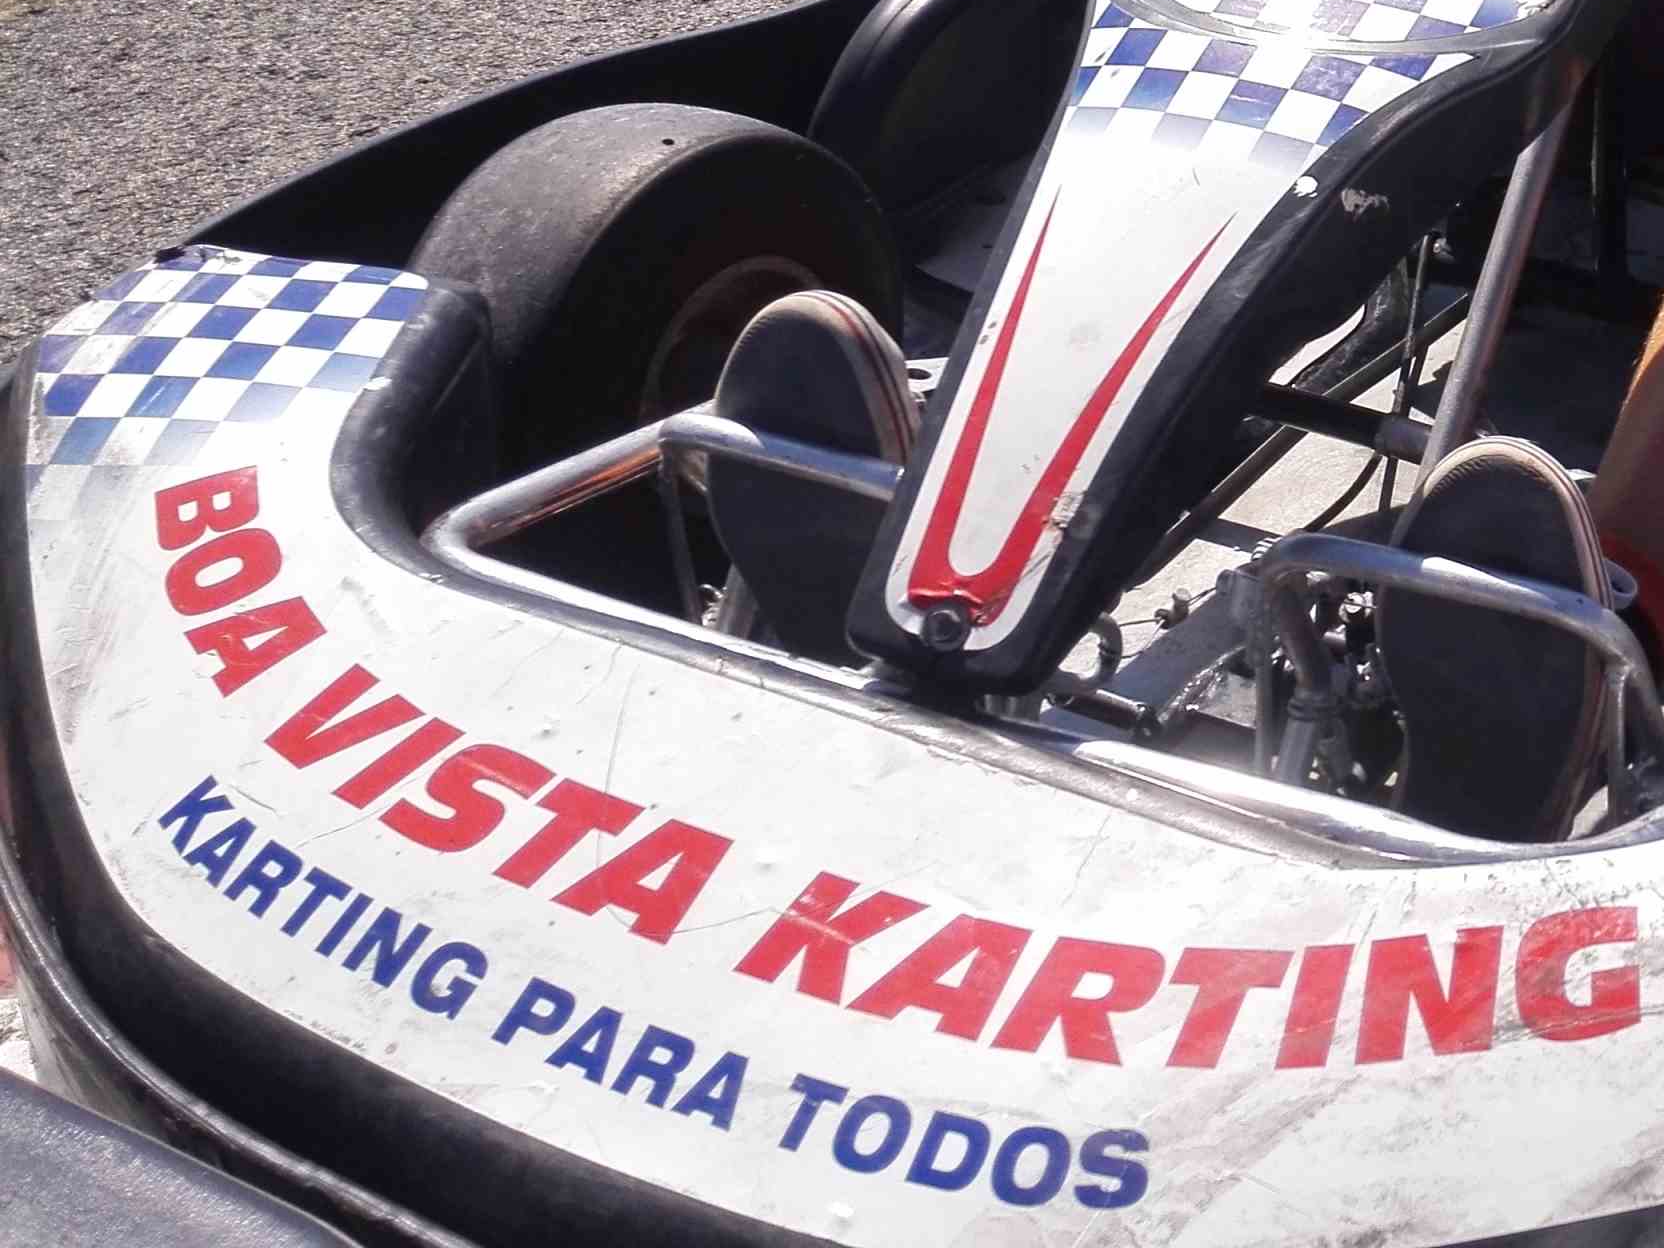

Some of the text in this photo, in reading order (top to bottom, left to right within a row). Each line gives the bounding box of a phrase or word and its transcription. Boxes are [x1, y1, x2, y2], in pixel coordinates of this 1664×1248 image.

[153, 465, 1641, 1070] BOA VISTA KARTING
[156, 774, 1152, 1210] KARTING PARA TODOS
